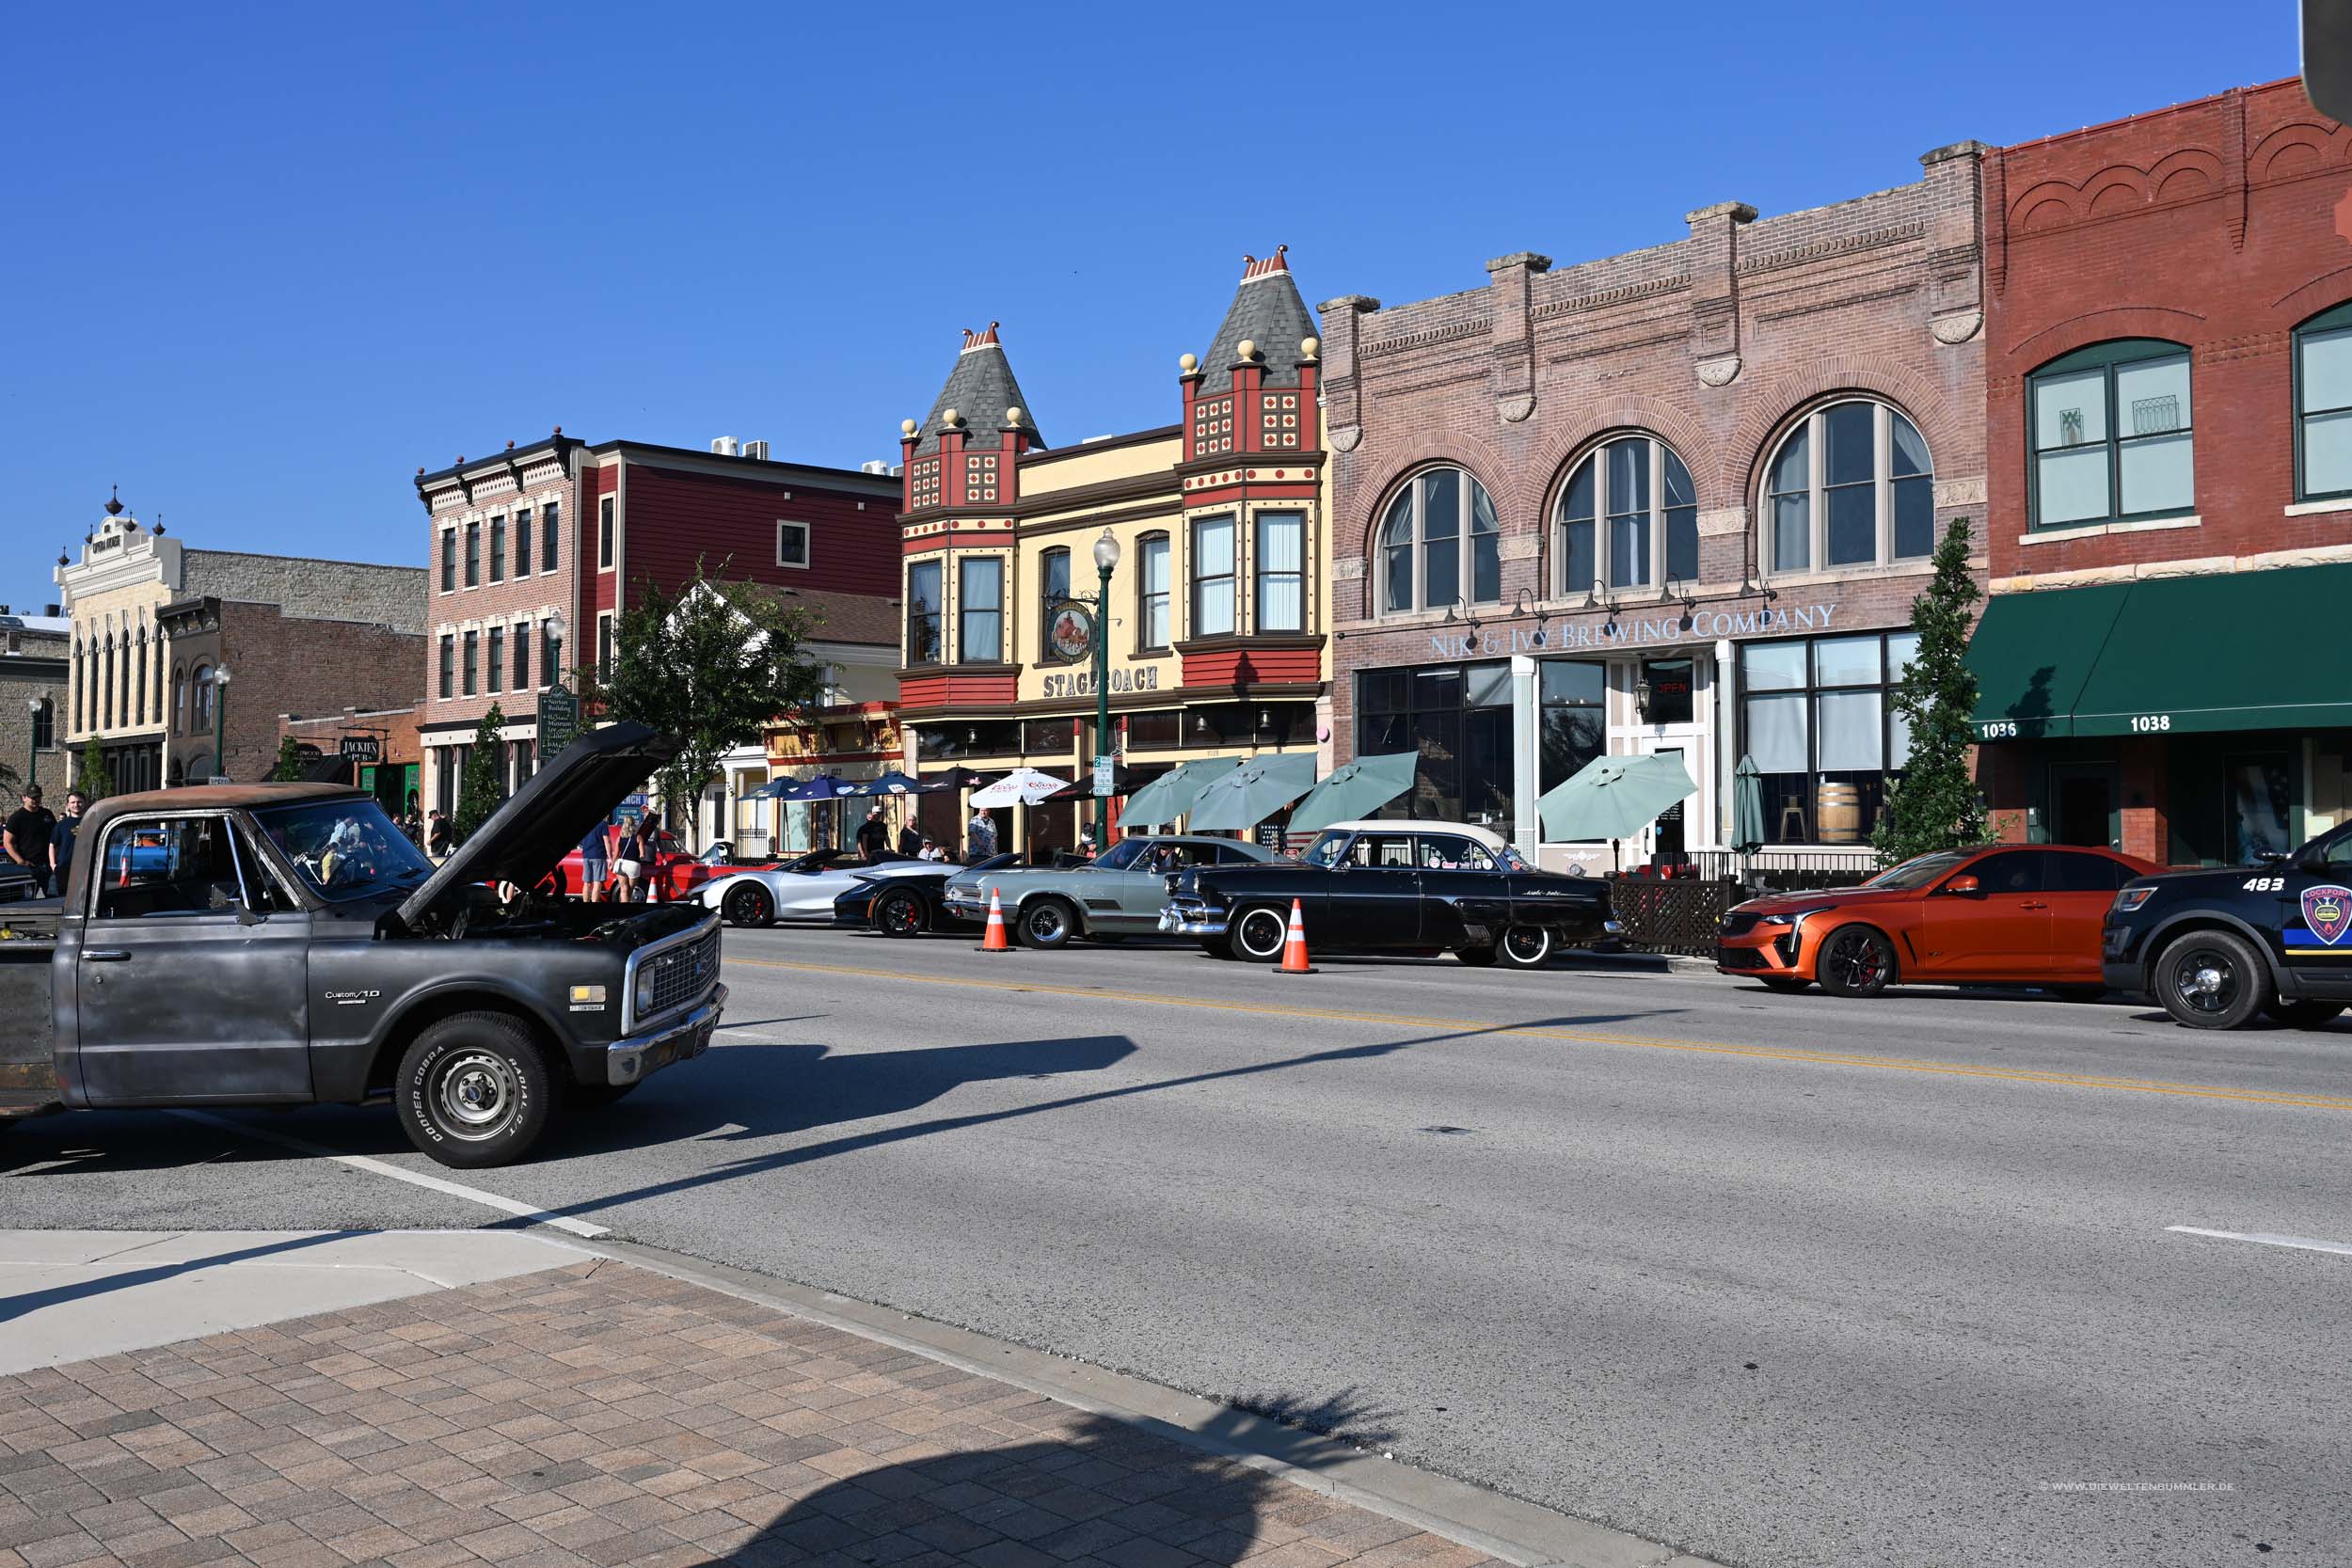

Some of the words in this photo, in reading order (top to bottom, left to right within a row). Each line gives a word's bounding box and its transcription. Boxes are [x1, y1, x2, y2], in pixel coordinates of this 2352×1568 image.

[1483, 631, 1502, 655] &
[1043, 666, 1158, 698] STAGEOACH
[1981, 721, 2017, 738] 1036
[2130, 715, 2171, 733] 1038
[342, 741, 377, 753] JACKIE'S
[1095, 758, 1101, 767] 2
[2242, 878, 2285, 893] 483
[2304, 888, 2350, 899] LOCKPORT
[414, 1045, 445, 1085] COBRA
[508, 1057, 528, 1110] RADIAL
[412, 1090, 444, 1143] COOPER
